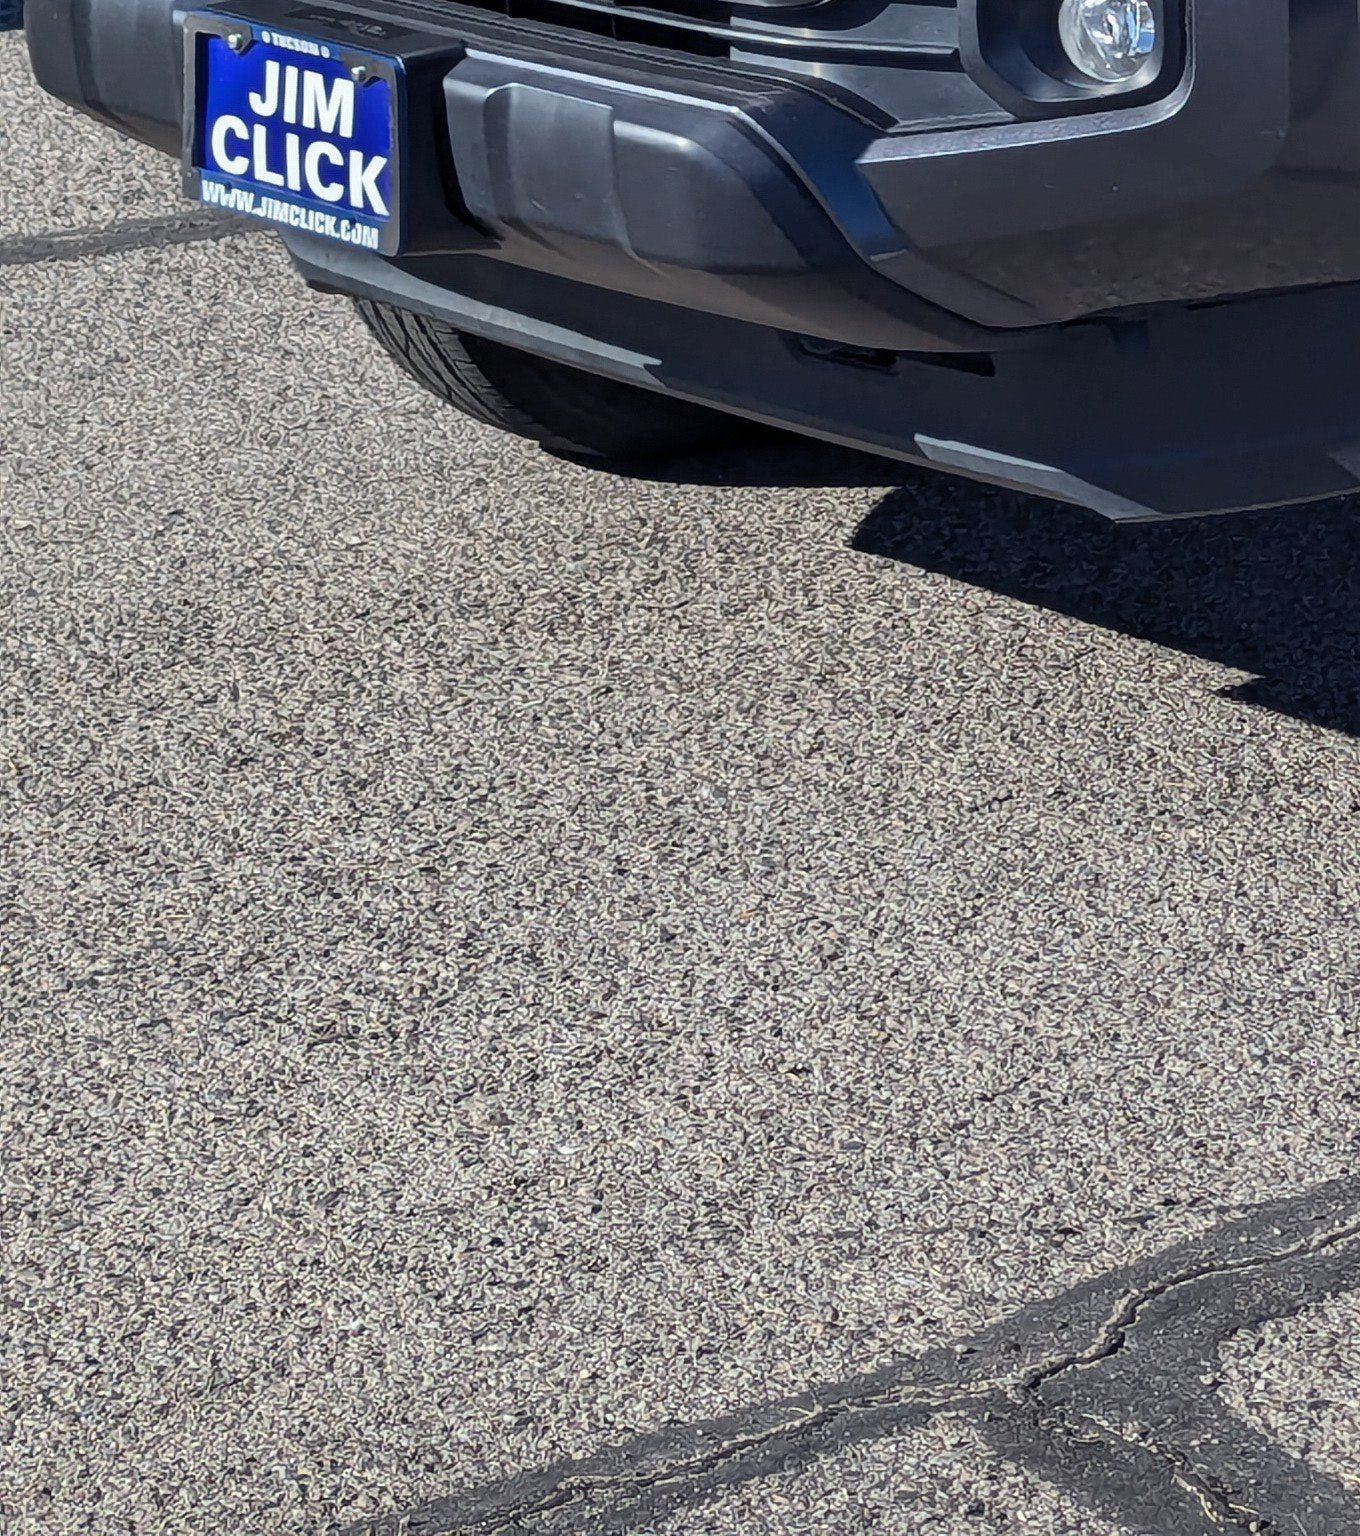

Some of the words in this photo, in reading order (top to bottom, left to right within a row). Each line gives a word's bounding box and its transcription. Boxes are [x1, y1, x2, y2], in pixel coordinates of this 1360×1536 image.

[248, 59, 355, 138] JIM
[211, 114, 390, 216] CLICK
[201, 179, 379, 250] WWW.JIMCLICK.COM
